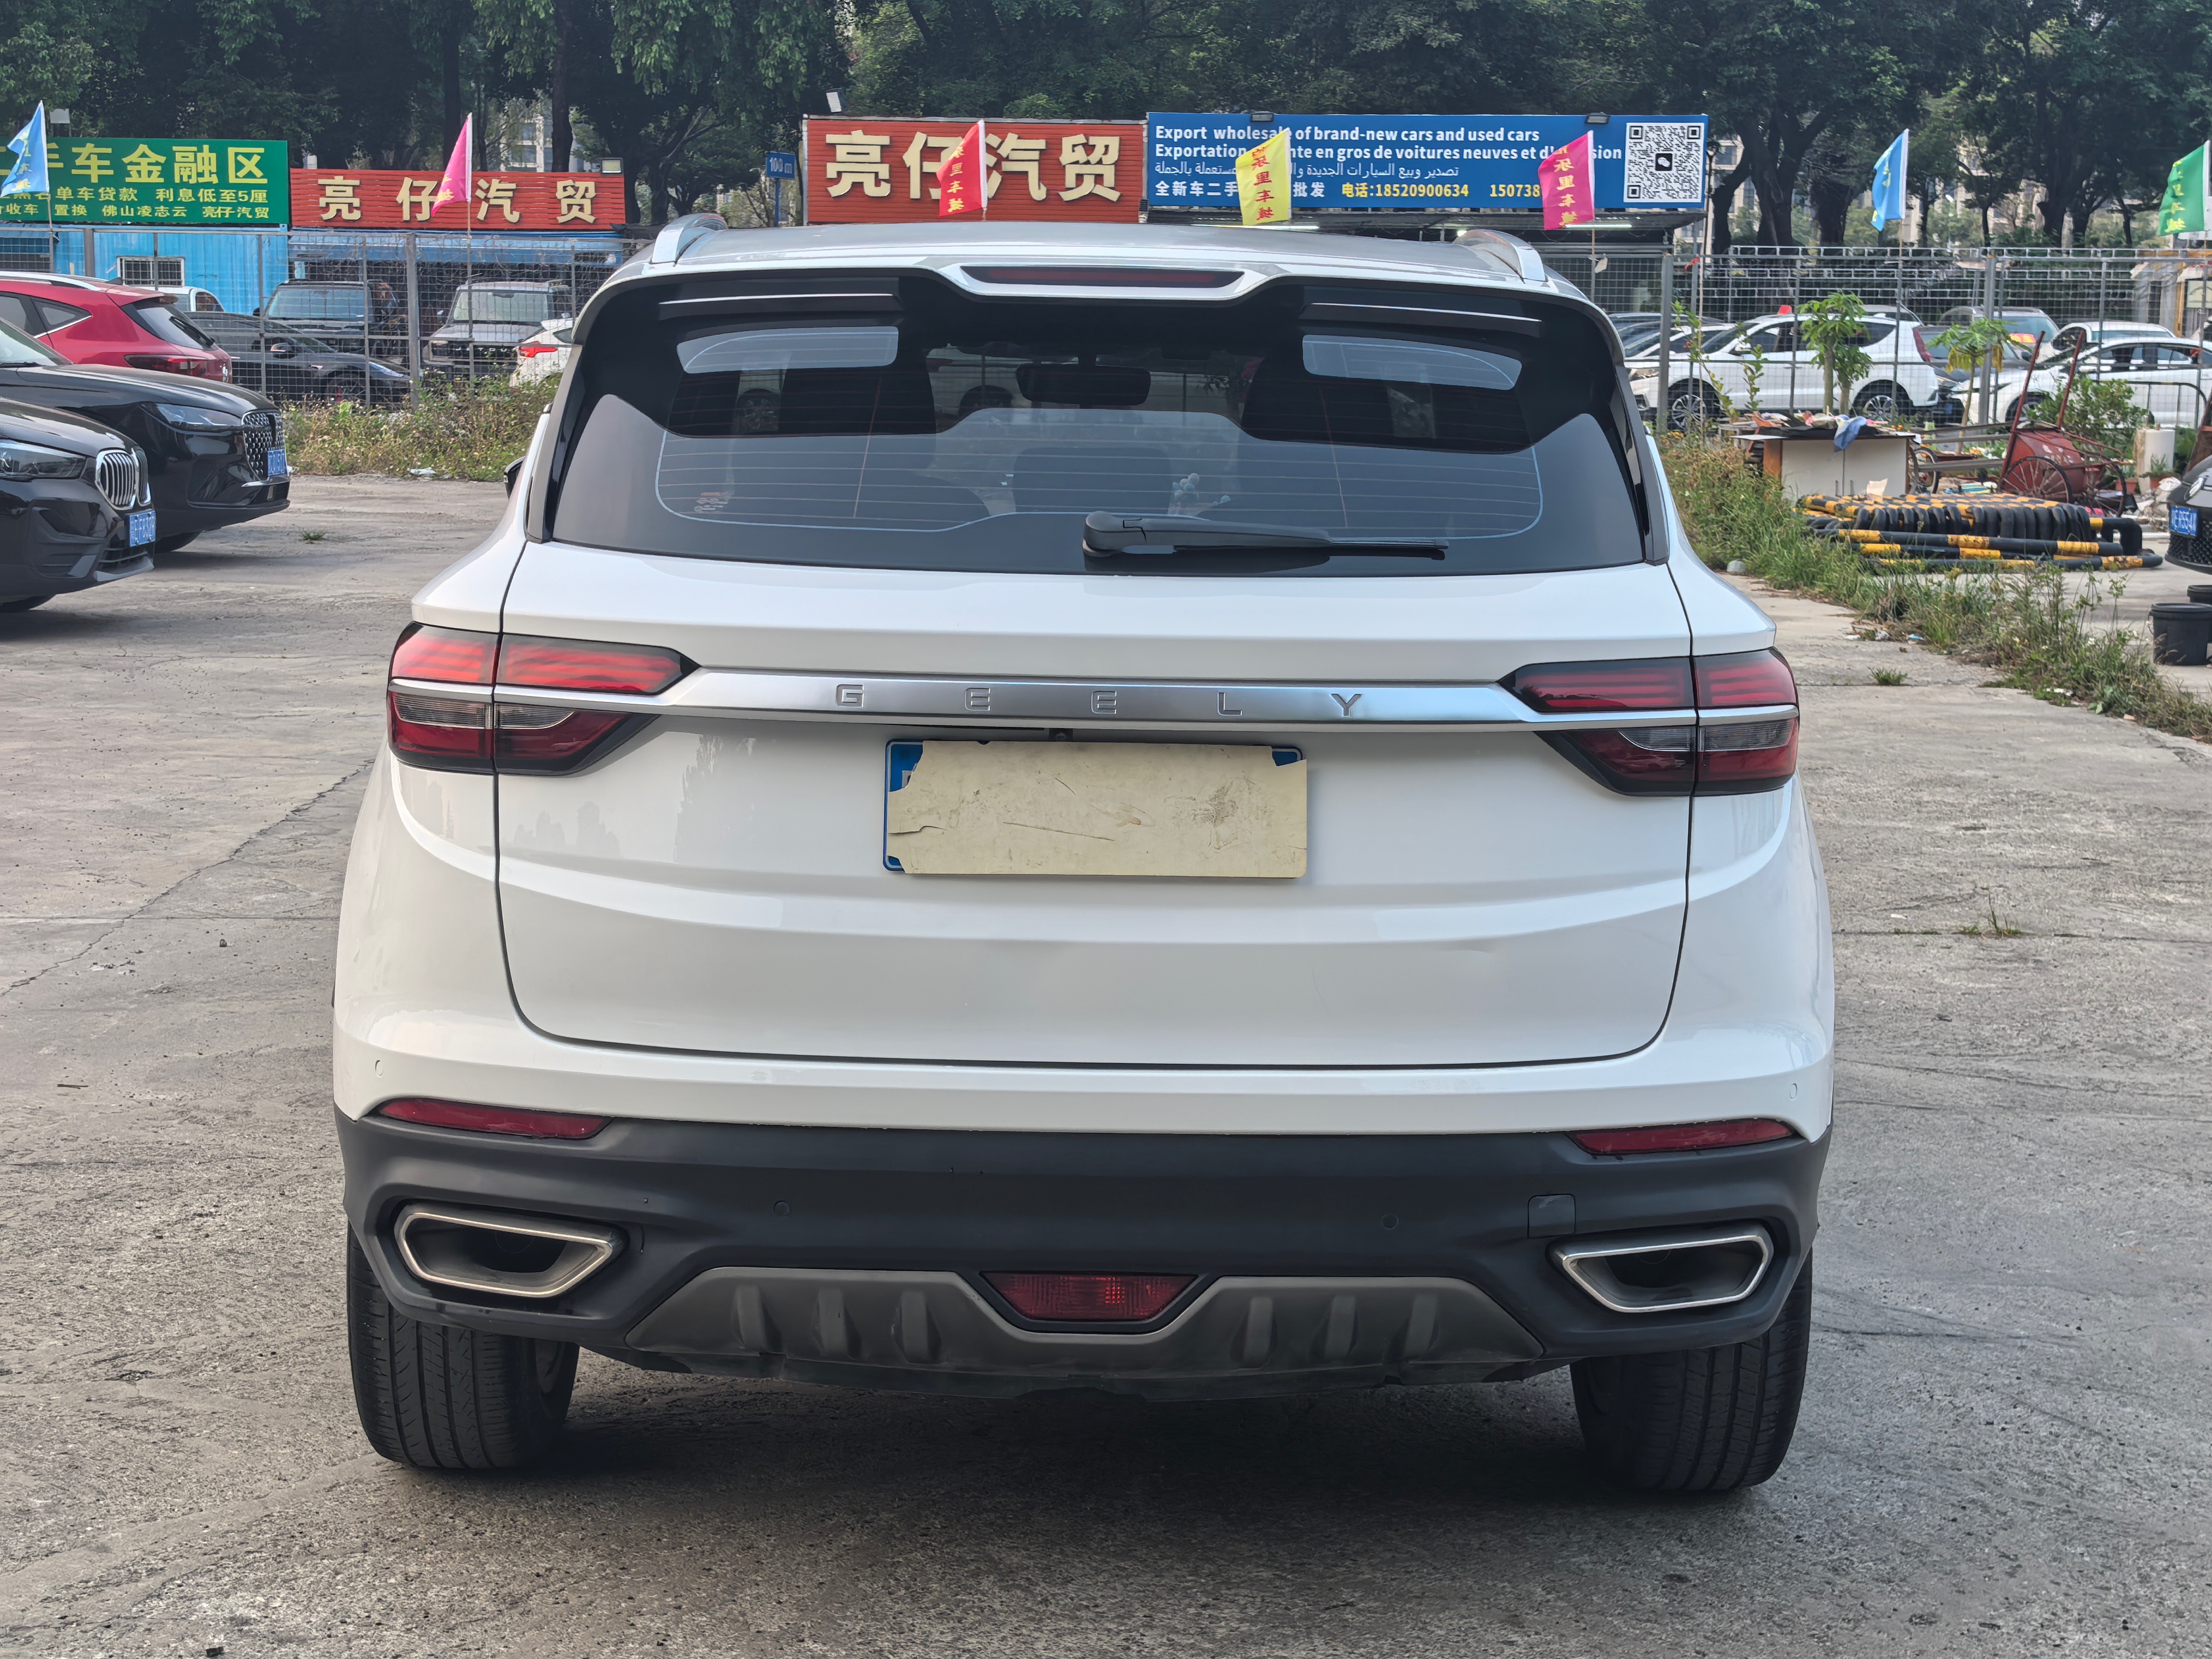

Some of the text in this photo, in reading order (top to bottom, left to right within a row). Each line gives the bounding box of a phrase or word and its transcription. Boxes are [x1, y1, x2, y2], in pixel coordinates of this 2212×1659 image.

[1156, 125, 1540, 141] Export wholesa of brand-new cars and used cars
[1156, 144, 1246, 160] Exportation
[1316, 149, 1334, 159] en
[1337, 148, 1371, 162] gros
[1374, 145, 1393, 159] de
[1395, 145, 1460, 159] voitures
[1463, 149, 1518, 159] neuves
[1521, 147, 1536, 159] et
[1155, 161, 1192, 176] بالجملة
[1306, 162, 1344, 177] الجديدة
[1346, 162, 1395, 179] السيارات
[1399, 167, 1421, 179] وبيع
[1424, 167, 1459, 179] تصدير
[156, 187, 268, 203] 利息低至5厘
[318, 176, 596, 224] 亮仔汽贸
[55, 204, 87, 217] 置换
[102, 205, 187, 218] 佛山凌志云
[202, 206, 269, 219] 亮仔汽贸
[835, 683, 1362, 718] GEELY
